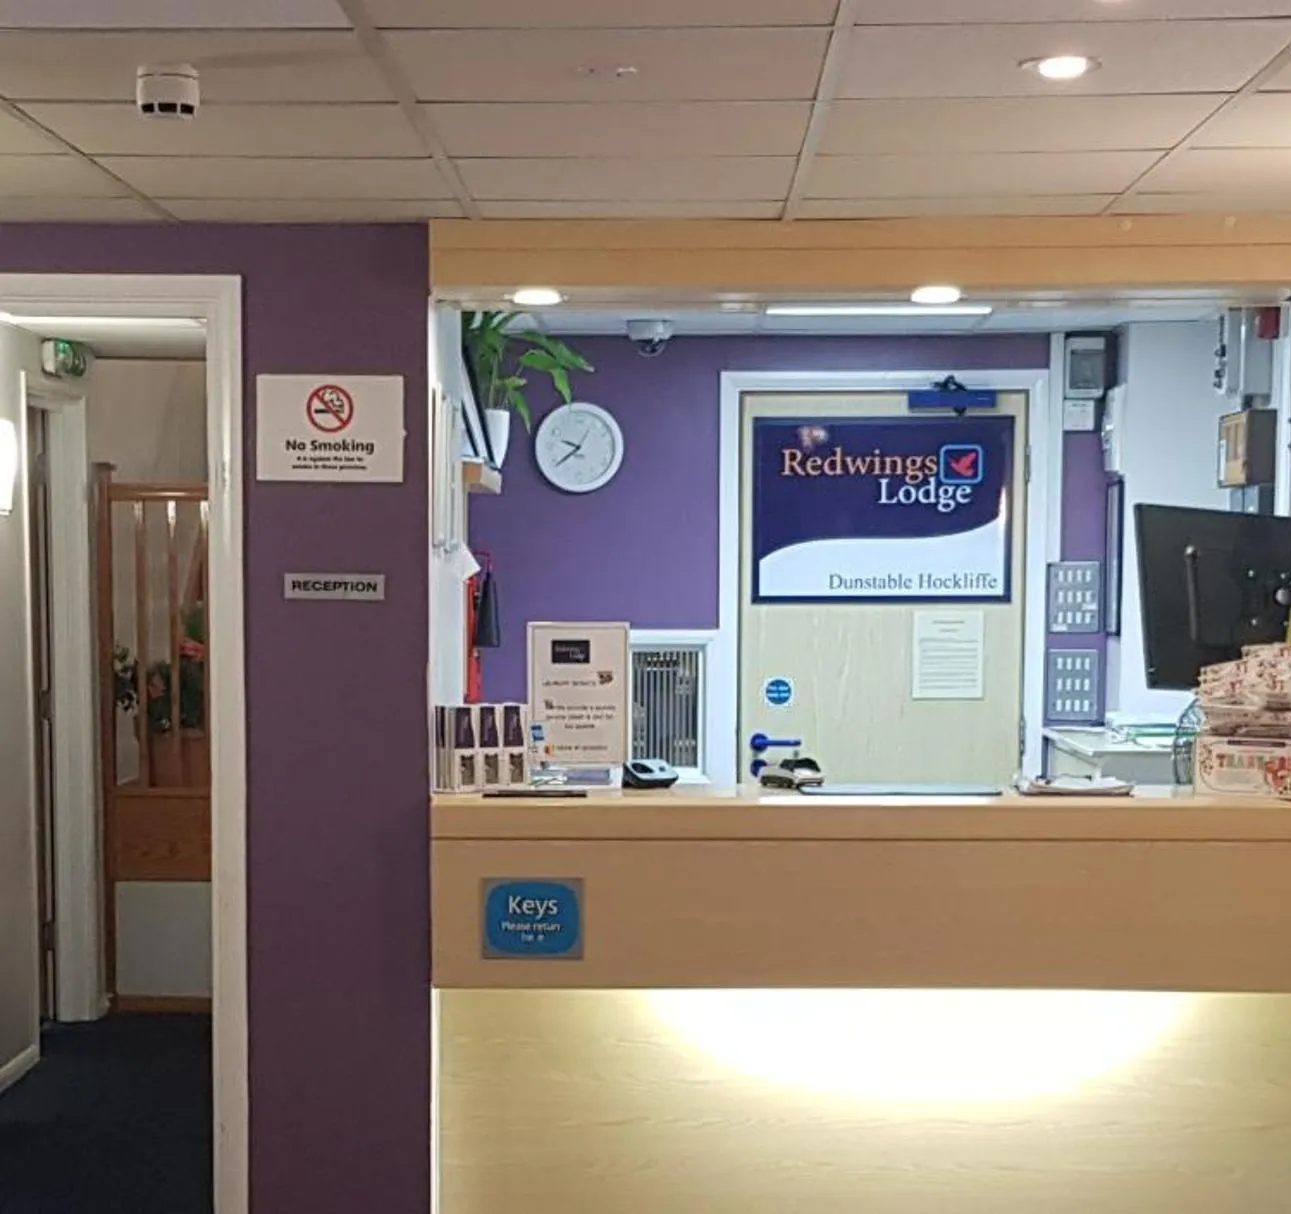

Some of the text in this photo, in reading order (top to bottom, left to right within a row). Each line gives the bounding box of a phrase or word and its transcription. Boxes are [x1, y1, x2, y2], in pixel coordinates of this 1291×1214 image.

[285, 439, 375, 455] No Smoking
[781, 447, 937, 484] Redwings
[878, 478, 972, 512] Lodge
[291, 580, 378, 592] RECEPTION
[829, 572, 998, 590] Dunstable Hockliffe
[508, 895, 558, 920] Keys
